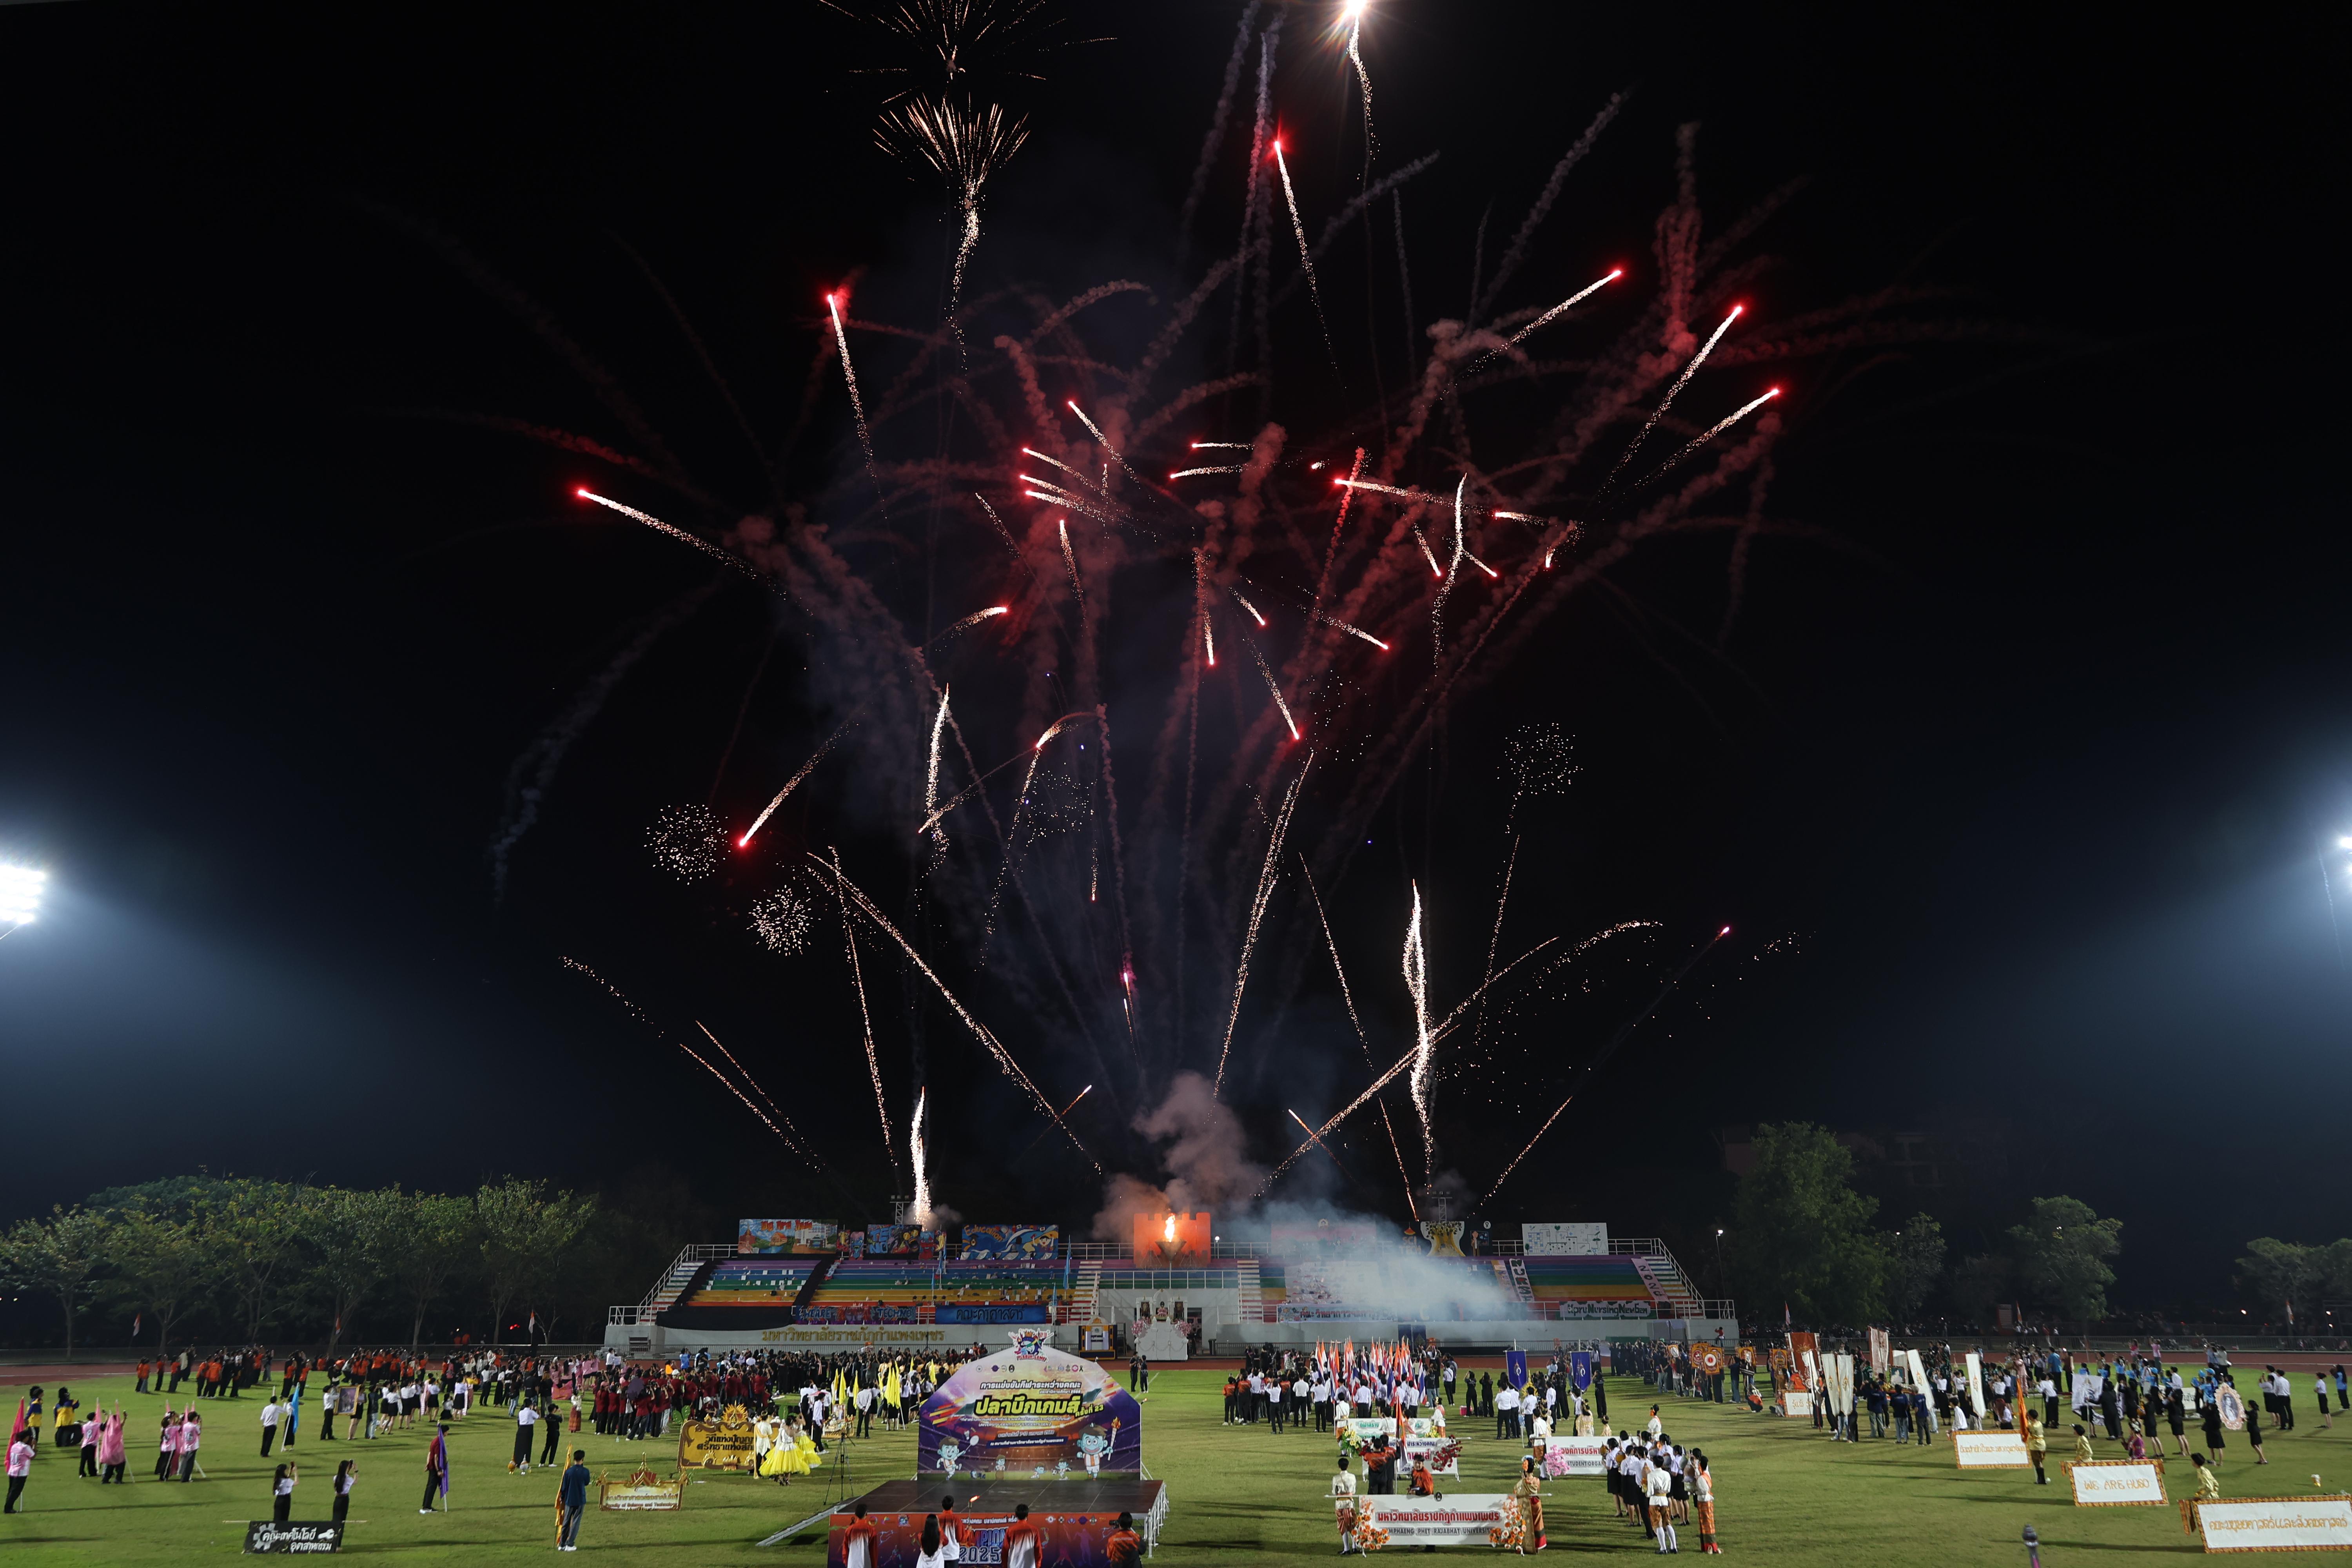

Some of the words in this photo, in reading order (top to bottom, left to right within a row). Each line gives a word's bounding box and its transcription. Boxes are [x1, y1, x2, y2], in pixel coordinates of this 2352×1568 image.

[956, 1308, 1025, 1322] คณะครุศาสตร์
[762, 1327, 945, 1342] มหาวิทยาลัยราชภัฏกำแพงเพชร
[980, 1380, 1081, 1390] การแข่งขันกีฬาระหว่างคณะ
[974, 1394, 1081, 1415] ปลาบึกเกมส์
[1094, 1404, 1104, 1412] 23
[2084, 1480, 2100, 1490] WE
[2104, 1480, 2125, 1490] ARE
[1377, 1509, 1501, 1524] มหาวิทยาลัยราชภัฏกำแพงเพชร
[262, 1527, 317, 1542] คณะเทคโนโลยี
[959, 1547, 1002, 1564] 2025
